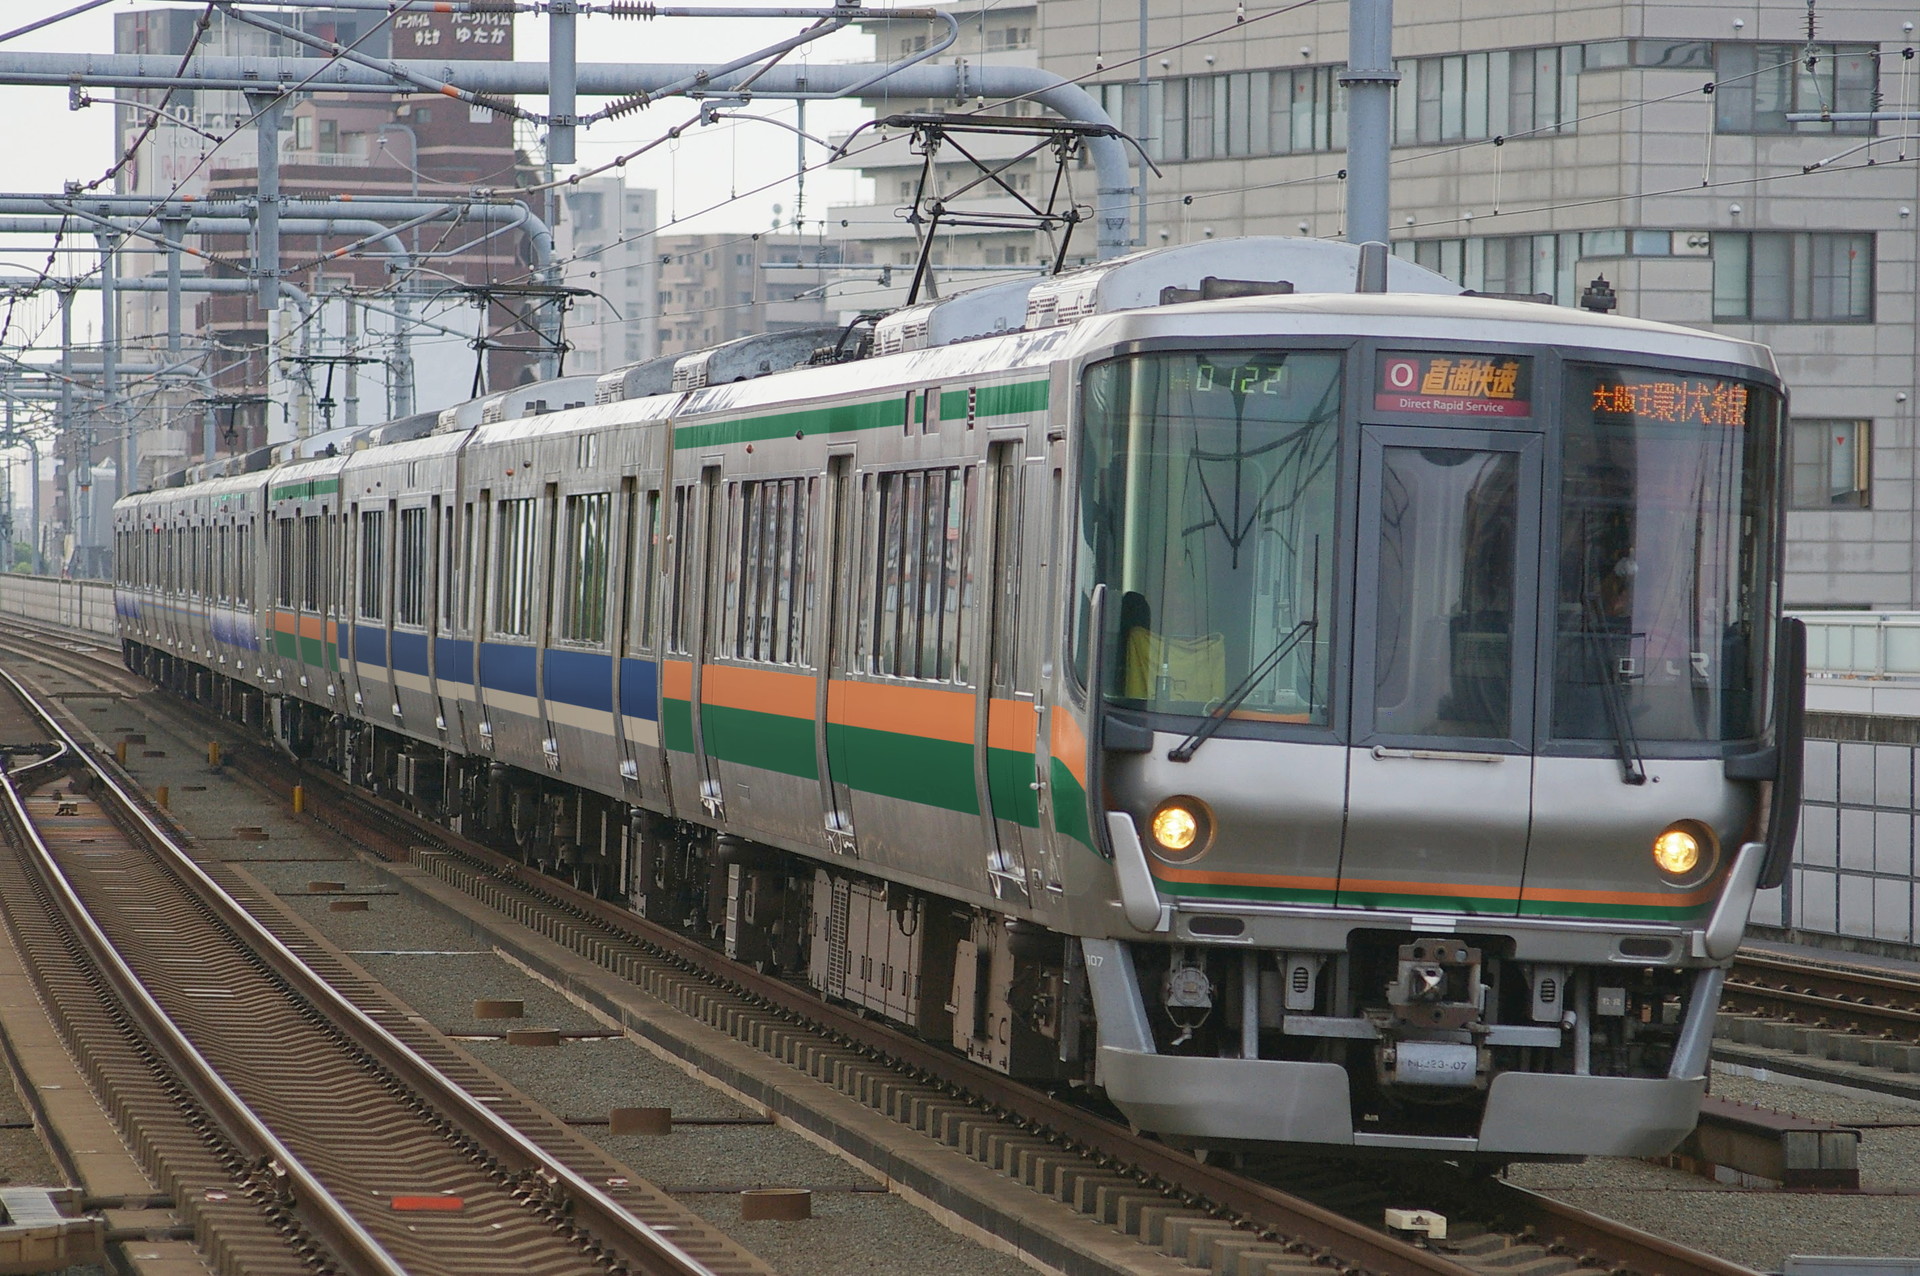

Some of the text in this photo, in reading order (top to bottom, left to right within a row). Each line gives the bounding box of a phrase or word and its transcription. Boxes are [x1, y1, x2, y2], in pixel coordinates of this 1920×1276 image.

[414, 29, 441, 46] ゆたか
[456, 27, 506, 44] ゆたか
[1421, 358, 1520, 399] 直通快速
[1400, 398, 1504, 413] Direct Rapid Service
[1592, 381, 1748, 425] 大阪環状線
[1086, 954, 1104, 968] 107
